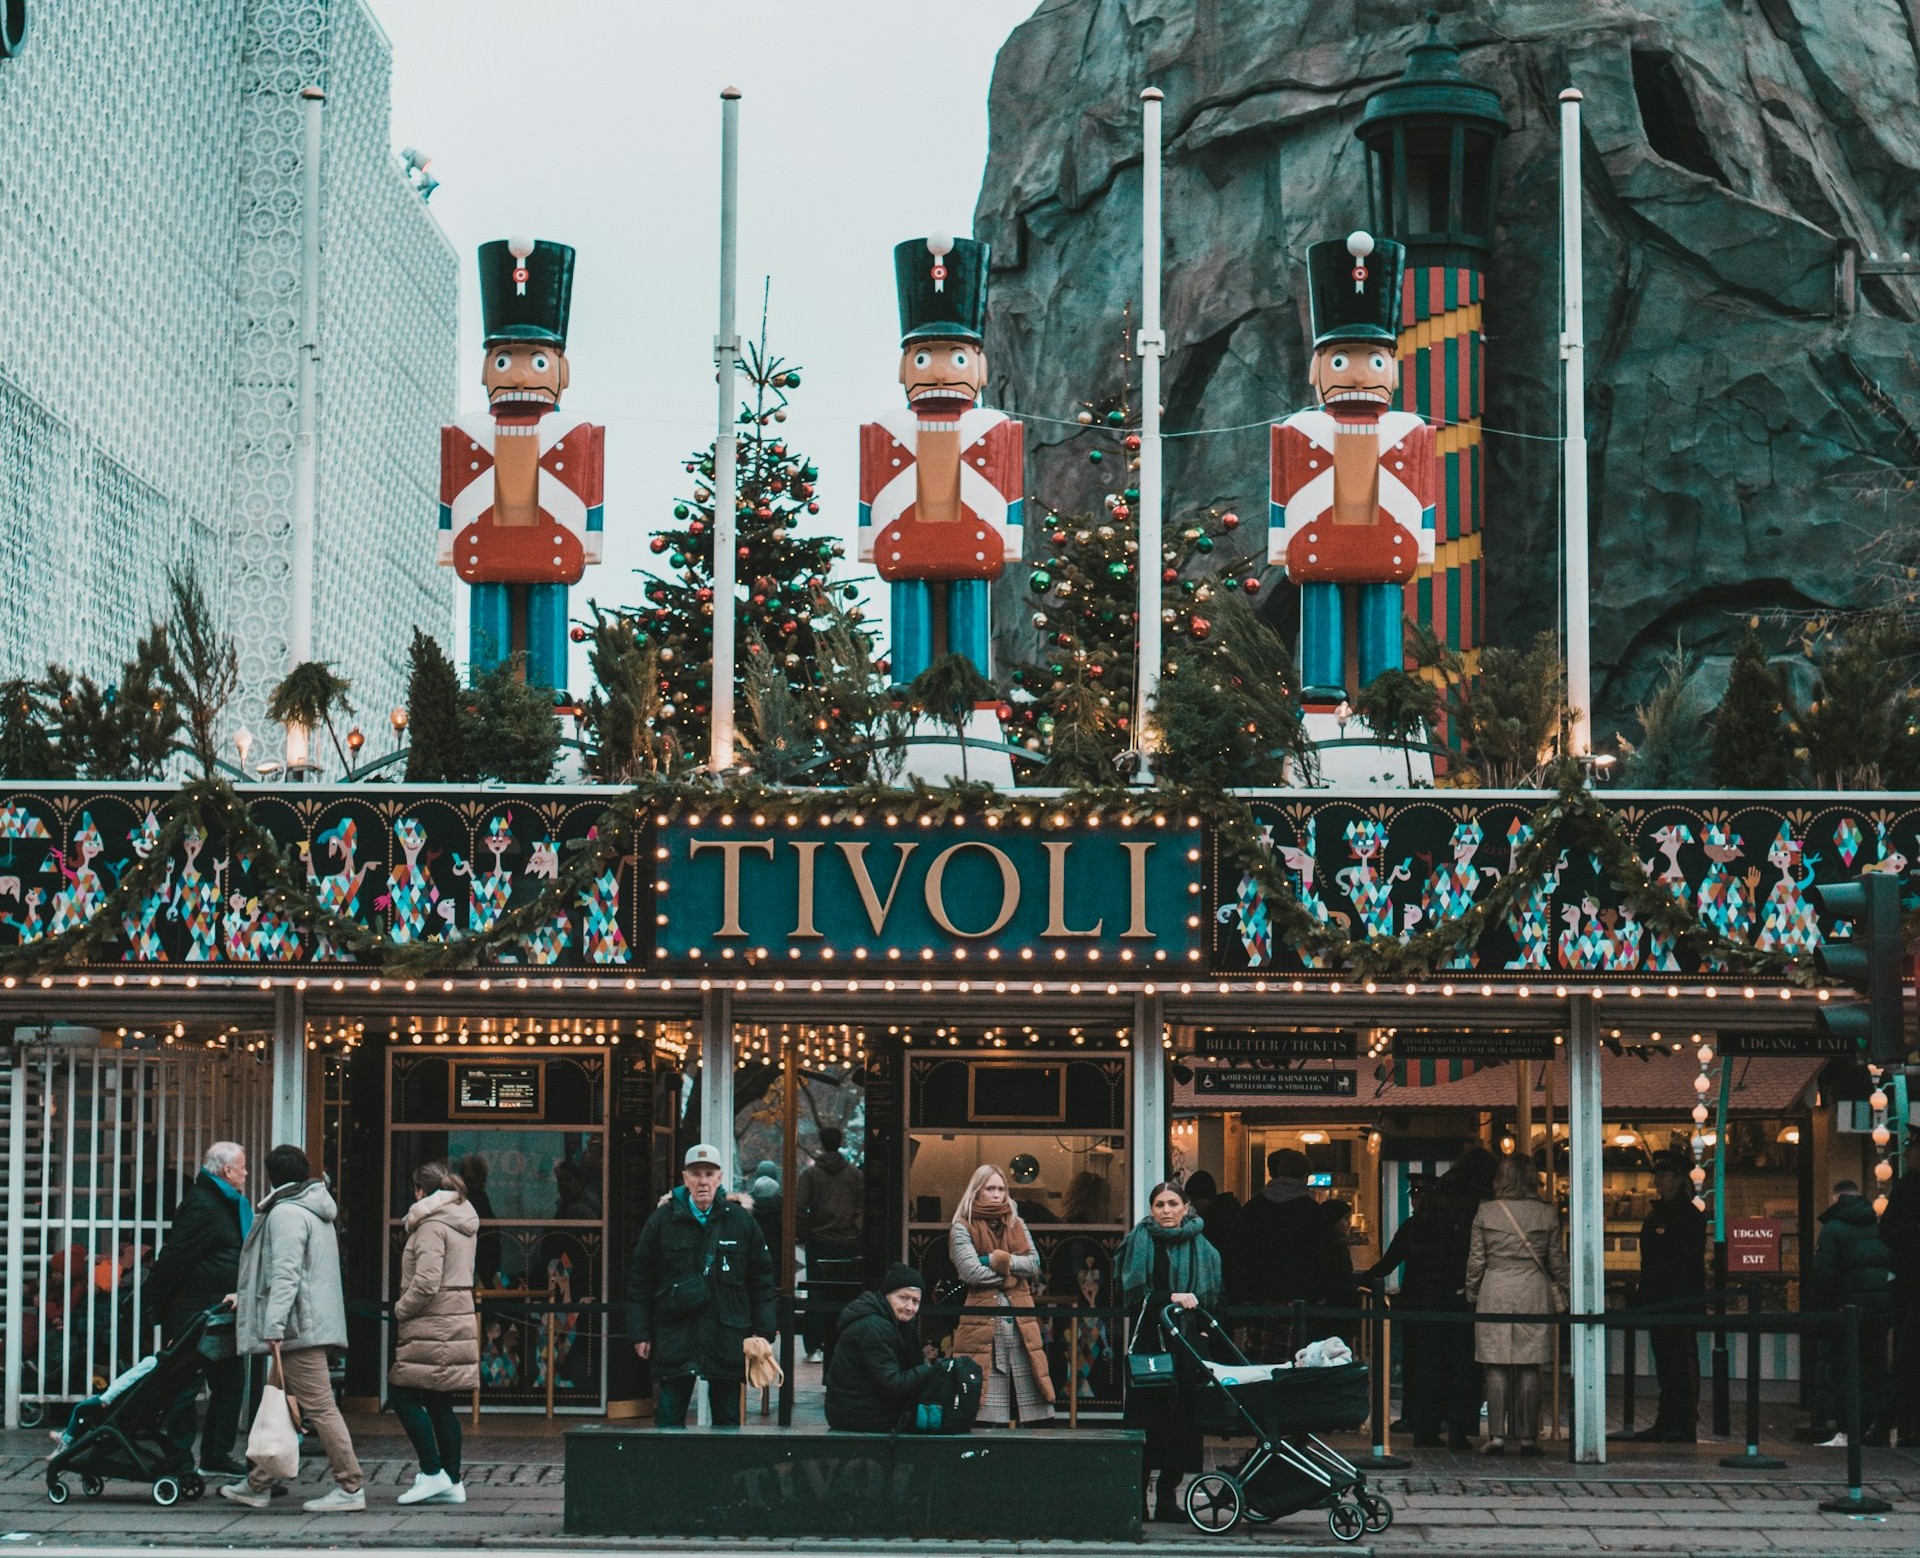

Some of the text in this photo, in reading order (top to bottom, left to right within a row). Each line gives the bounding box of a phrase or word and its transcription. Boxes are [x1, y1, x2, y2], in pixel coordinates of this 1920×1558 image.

[689, 837, 1158, 939] TIVOLI
[1206, 1038, 1279, 1051] BILLETTER
[1291, 1039, 1347, 1052] TICKETS
[1741, 1037, 1849, 1050] UDGANG EXIT
[1733, 1228, 1774, 1239] UDGANG
[1742, 1254, 1766, 1264] EXIT
